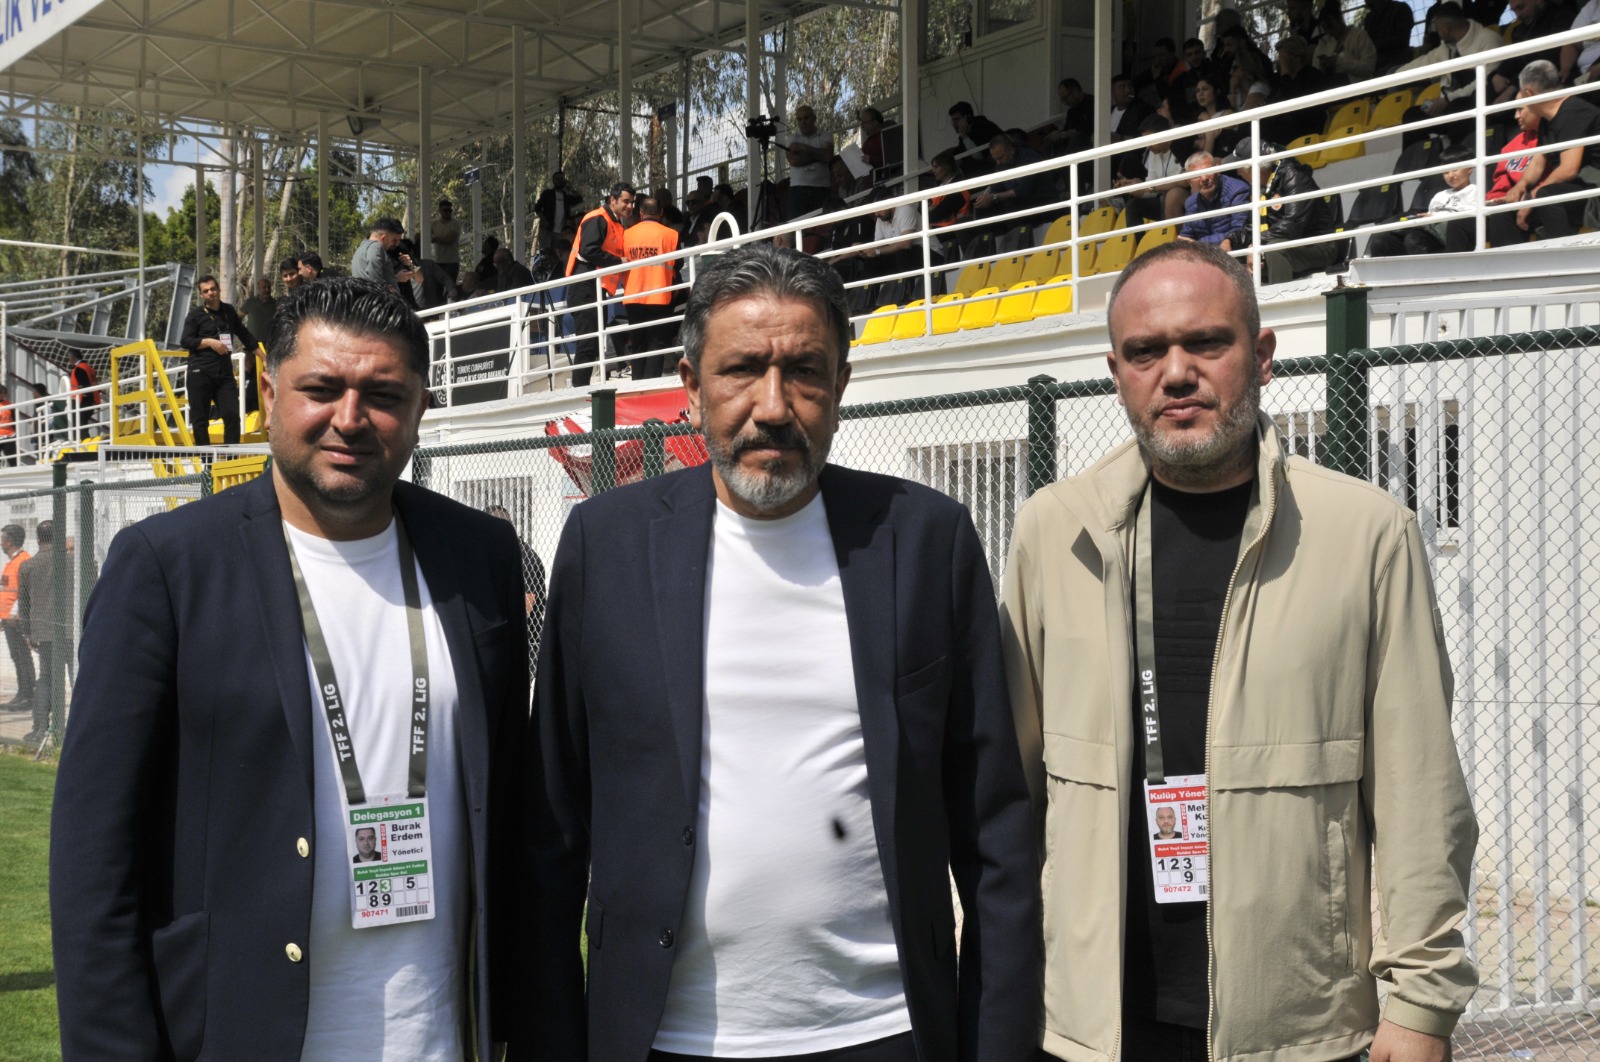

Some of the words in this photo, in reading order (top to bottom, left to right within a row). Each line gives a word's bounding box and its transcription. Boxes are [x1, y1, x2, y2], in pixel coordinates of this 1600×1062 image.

[1144, 698, 1156, 712] 2.
[332, 713, 345, 729] 2.
[414, 707, 427, 721] 2.
[1145, 717, 1158, 745] TFF
[335, 732, 351, 762] TFF
[412, 725, 425, 755] TFF
[1150, 791, 1177, 801] Kulüp
[353, 809, 412, 822] Delegasyon
[415, 806, 421, 815] 1
[392, 822, 421, 832] Burak
[391, 832, 423, 842] Erdem
[392, 847, 423, 856] Yönetici
[1158, 859, 1165, 871] 1
[1170, 858, 1180, 870] 2
[1183, 857, 1193, 870] 3
[1184, 870, 1194, 883] 9
[356, 883, 364, 895] 1
[368, 881, 378, 894] 2
[381, 879, 391, 893] 3
[406, 876, 416, 889] 5
[370, 895, 378, 908] 8
[382, 893, 391, 906] 9
[361, 909, 389, 918] 907471
